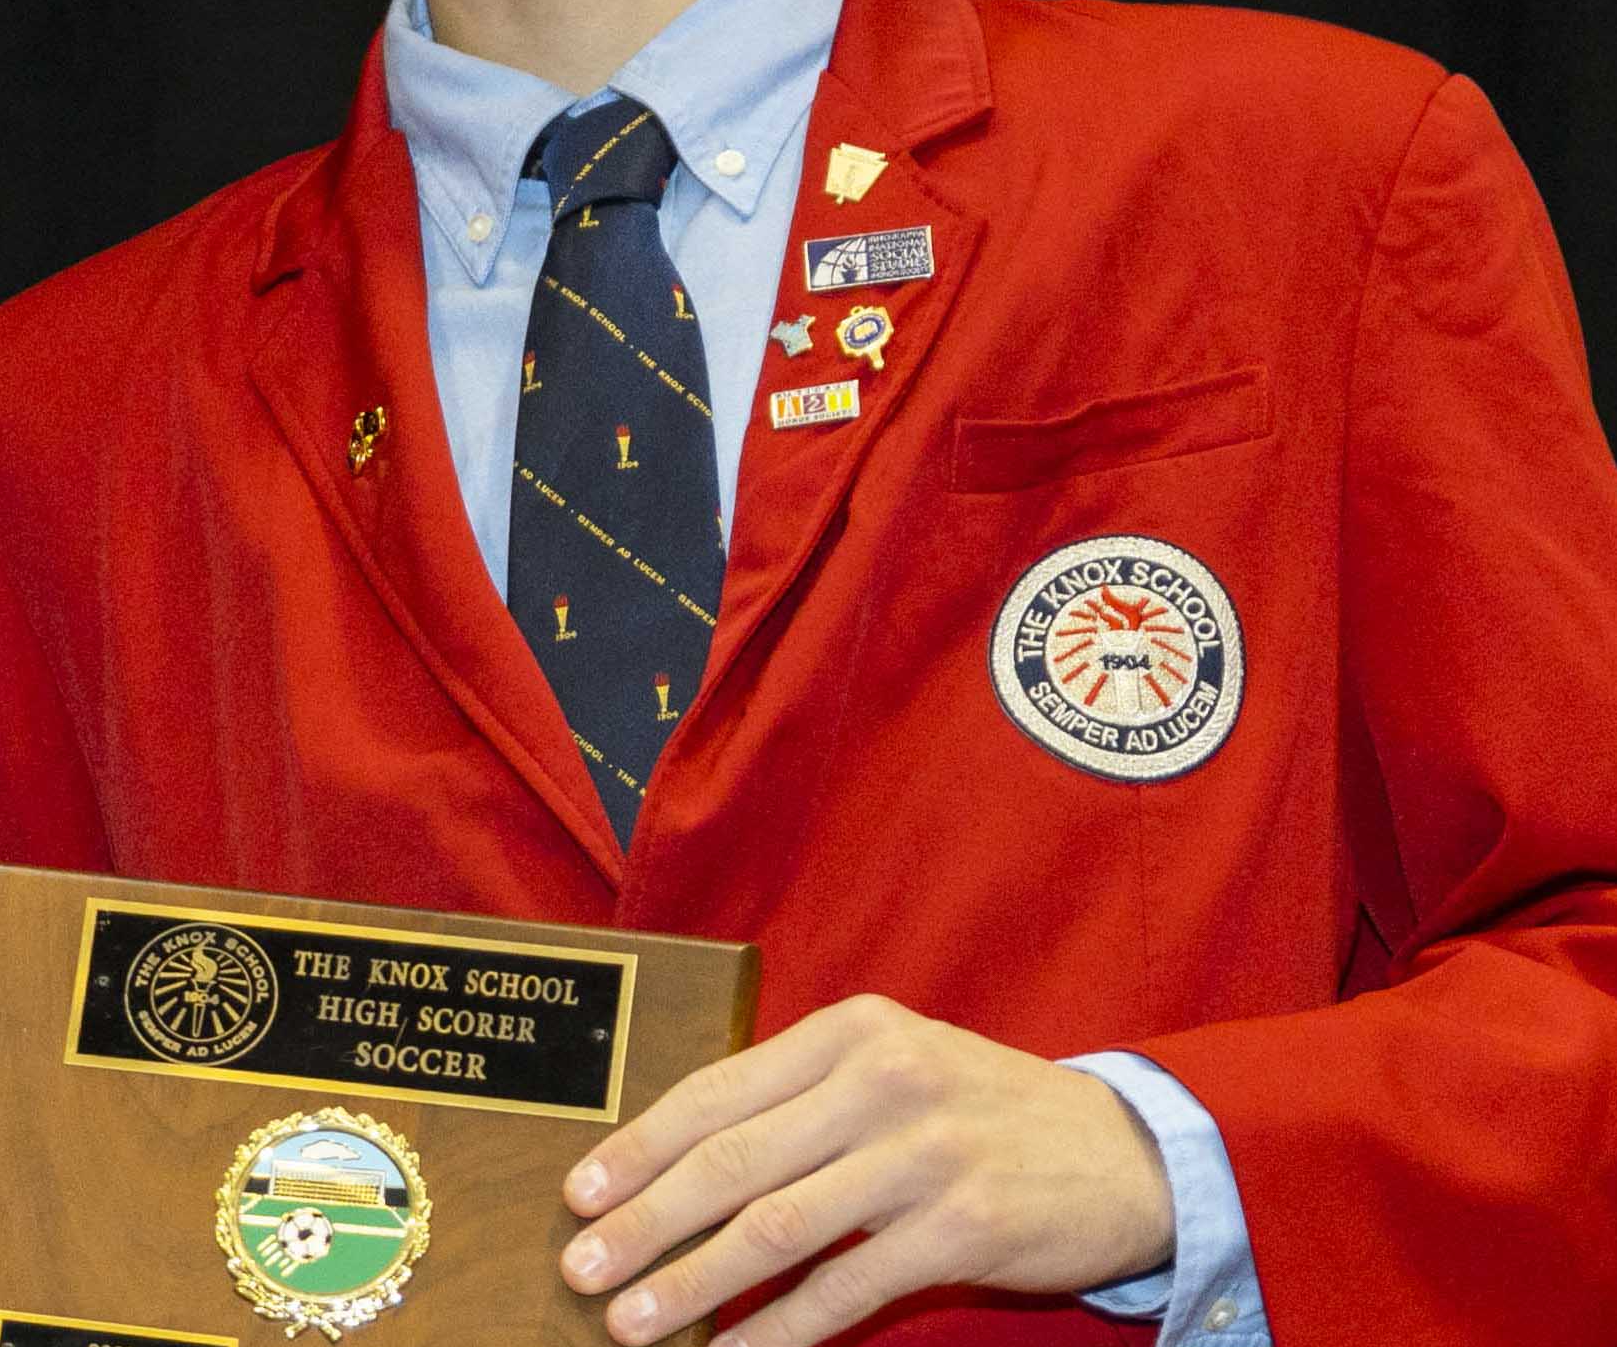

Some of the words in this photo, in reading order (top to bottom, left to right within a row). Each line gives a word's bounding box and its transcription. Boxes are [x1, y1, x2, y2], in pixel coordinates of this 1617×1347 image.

[561, 287, 588, 308] KNOX
[589, 307, 625, 342] SCHOOL
[638, 351, 657, 369] THE
[658, 370, 685, 393] KNOX
[535, 479, 567, 507] LUCEM
[577, 513, 615, 547] SEMPER
[616, 547, 632, 559] AD
[633, 558, 666, 586] LUCEM
[1017, 608, 1053, 662] THE
[1041, 559, 1123, 610] KNOX
[1130, 560, 1221, 658] SCHOOL
[1098, 653, 1153, 670] 1904
[1029, 680, 1119, 749] SEMPER
[1125, 729, 1158, 751] AD
[1160, 680, 1220, 743] LUCEM
[616, 768, 638, 789] THE
[135, 952, 161, 987] THE
[162, 931, 216, 953] KNOX
[225, 938, 269, 1003] SCHOOL
[294, 950, 351, 981] THE
[368, 958, 450, 992] KNOX
[464, 968, 580, 1005] SCHOOL
[186, 1046, 209, 1057] AD
[214, 1020, 258, 1054] LUCEM
[317, 995, 401, 1028] HIGH
[417, 1006, 536, 1042] SCORER
[354, 1041, 487, 1080] SOCCER
